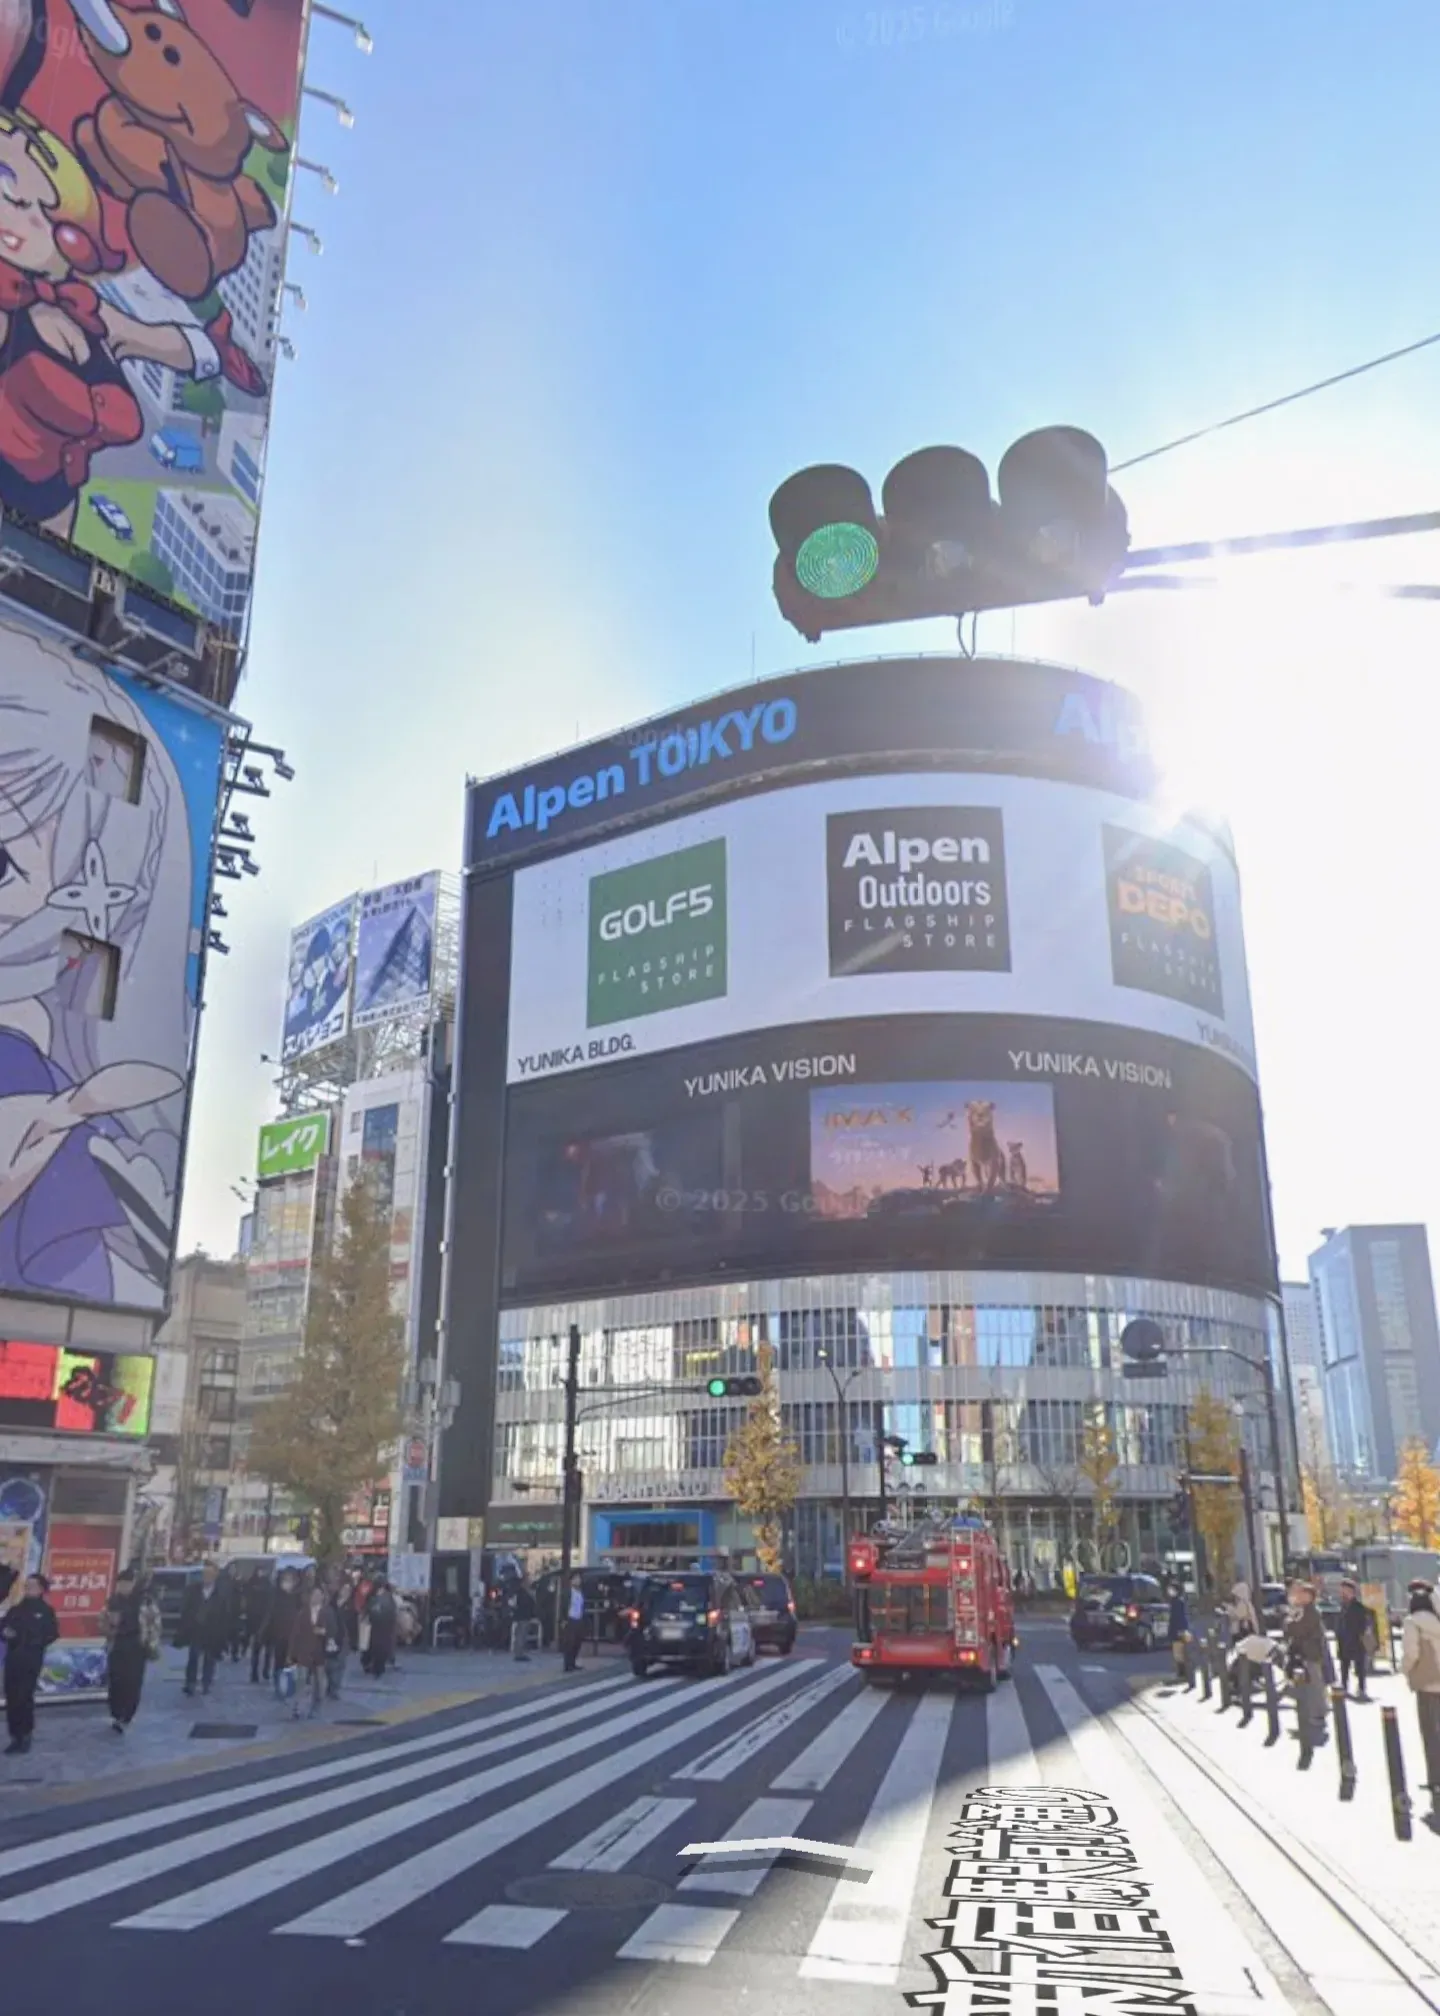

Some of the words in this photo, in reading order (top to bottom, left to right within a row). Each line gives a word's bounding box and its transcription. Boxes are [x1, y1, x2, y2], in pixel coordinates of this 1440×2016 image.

[486, 762, 625, 839] Alpen
[842, 830, 990, 873] Alpen
[858, 873, 992, 910] Outdoors
[1118, 878, 1211, 940] DEPO
[600, 883, 714, 942] GOLF5
[843, 914, 995, 933] FLAGSHIP
[901, 932, 996, 948] STORE
[598, 944, 715, 985] FLAGSHIP
[640, 964, 715, 995] STORE
[518, 1040, 584, 1075] YUNIKA
[588, 1033, 637, 1062] BLDG.
[1008, 1049, 1102, 1078] YUNIKA
[1104, 1057, 1174, 1091] VISION
[684, 1066, 767, 1099] YUNIKA
[771, 1053, 857, 1083] VISION
[824, 1103, 916, 1134] IMAX
[261, 1123, 321, 1160] レイク
[49, 1570, 107, 1591] エスパス
